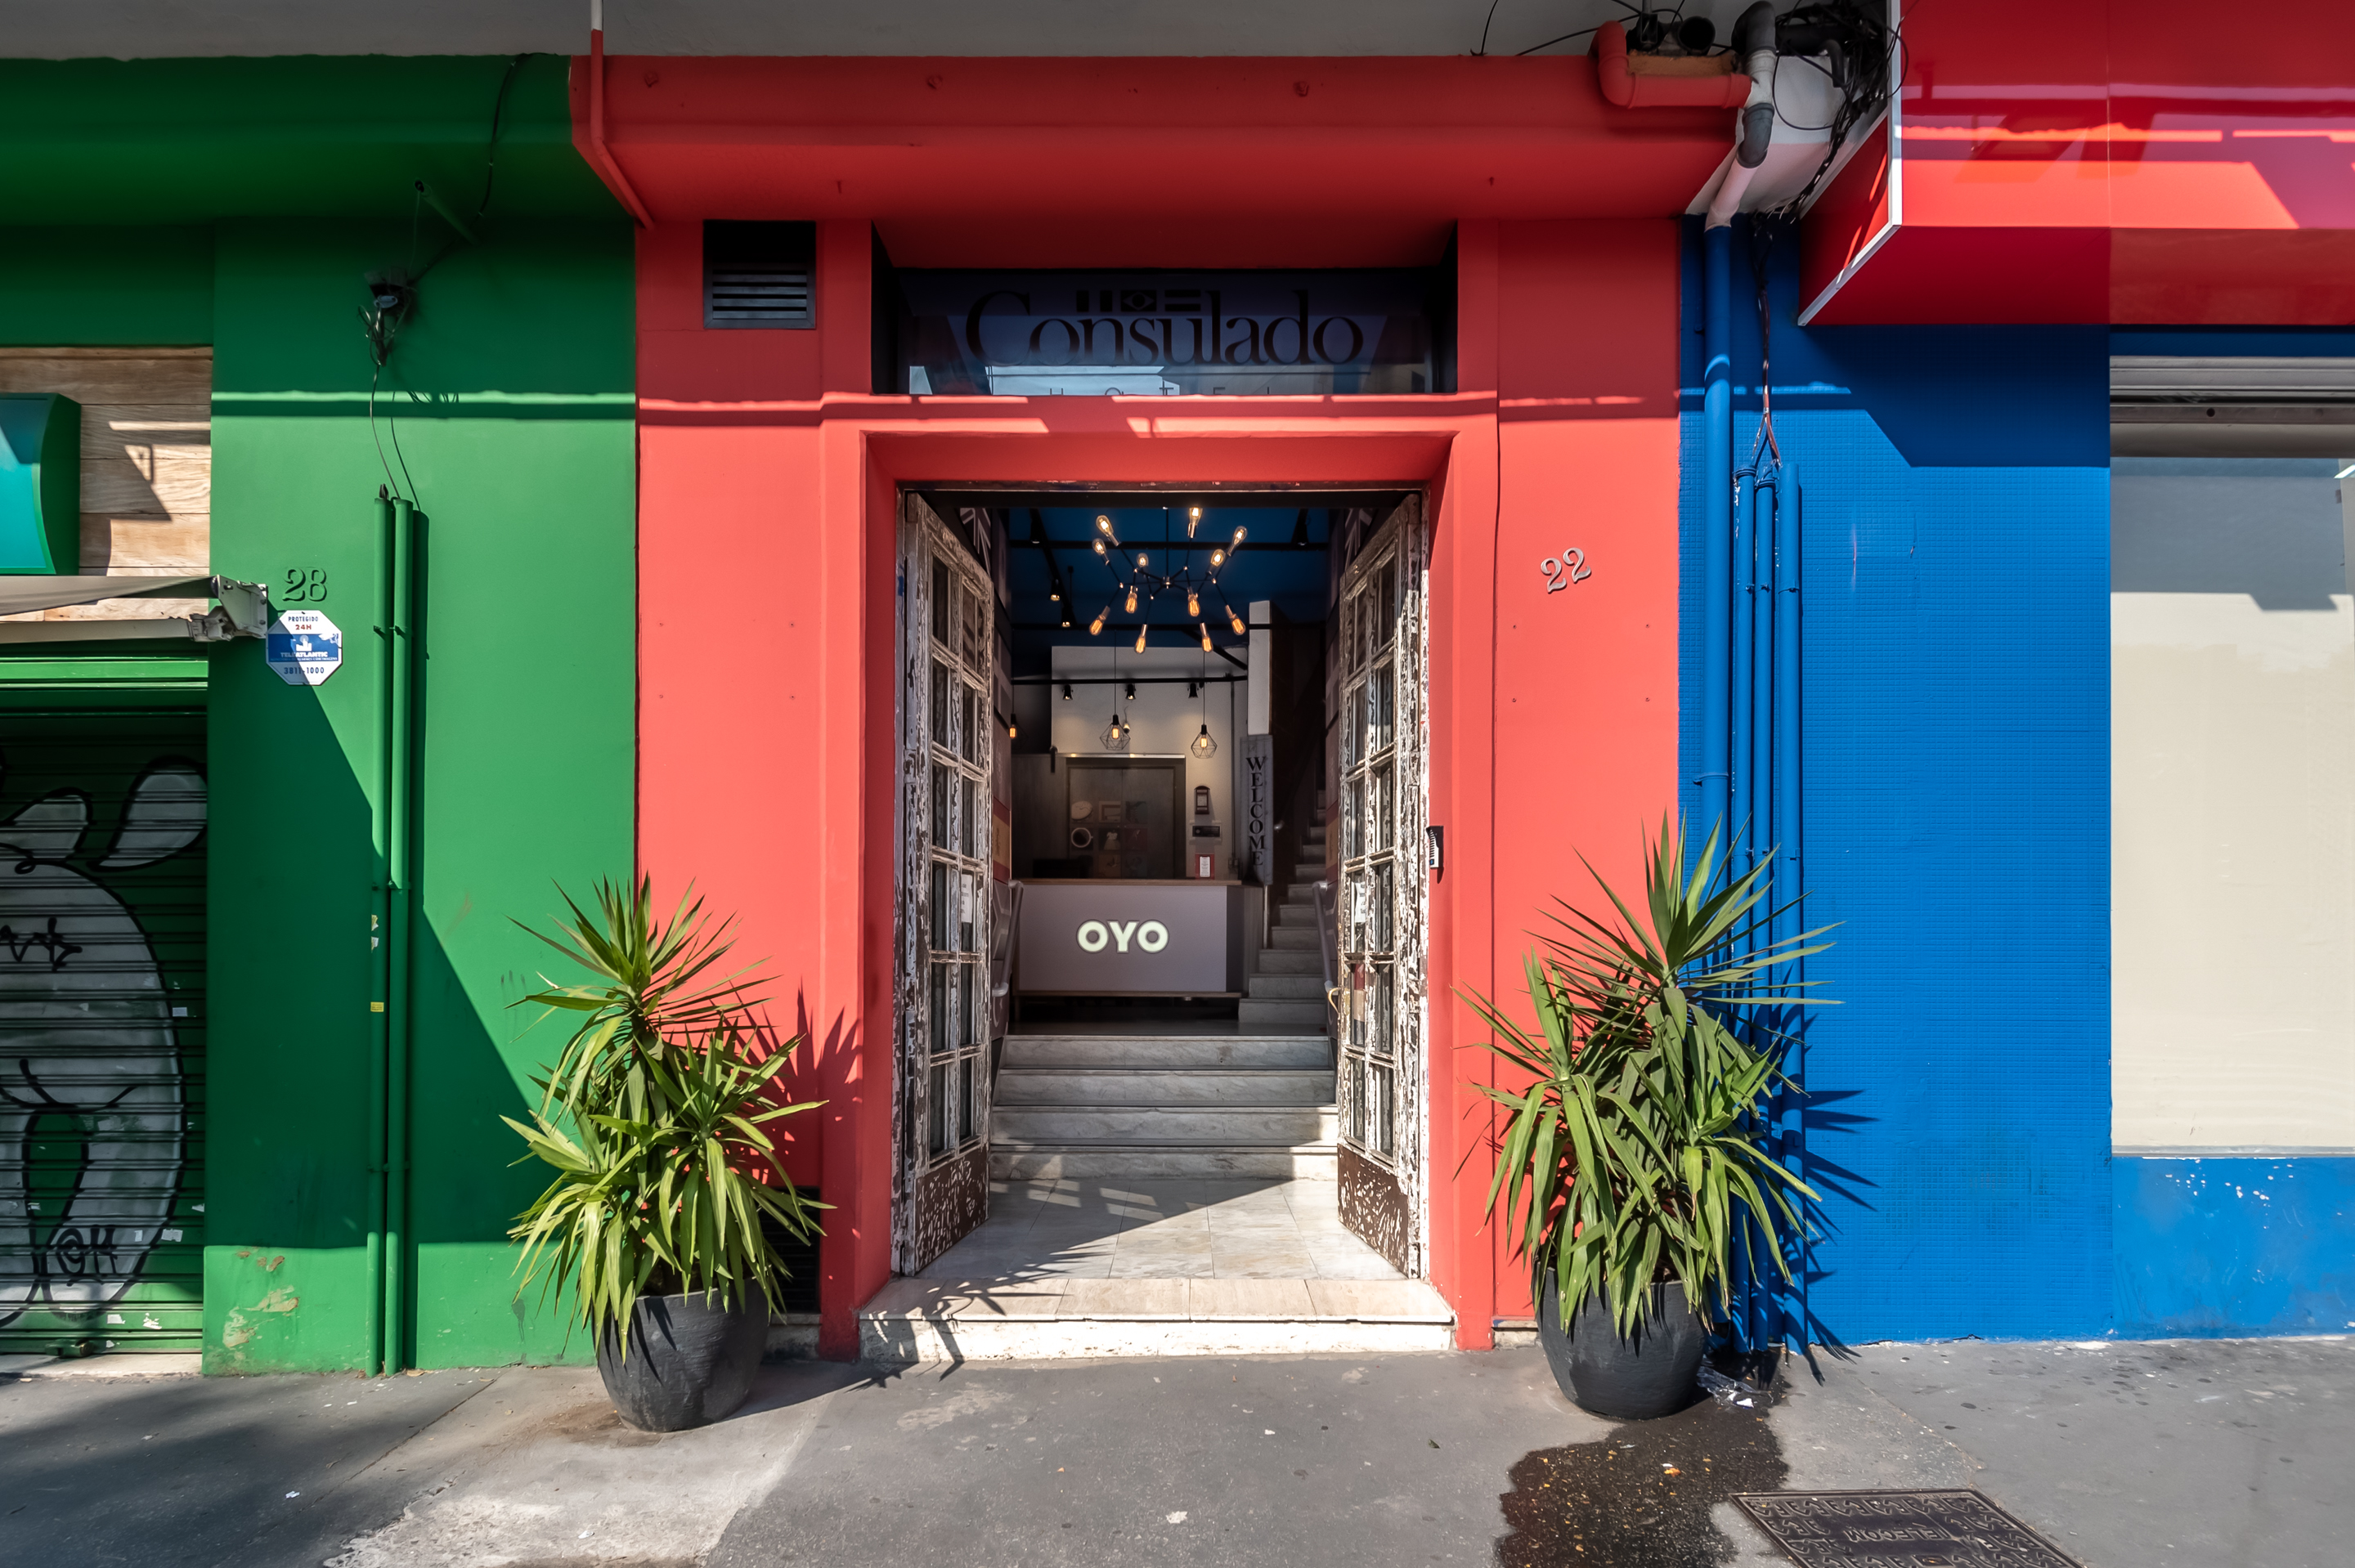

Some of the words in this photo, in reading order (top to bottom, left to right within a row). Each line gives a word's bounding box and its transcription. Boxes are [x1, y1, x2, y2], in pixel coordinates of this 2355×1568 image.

[966, 289, 1364, 366] Consulado
[282, 567, 328, 602] 28
[1540, 547, 1591, 594] 22
[284, 666, 325, 674] 3811-1000
[1245, 756, 1267, 866] WELCOME
[1076, 919, 1169, 954] OYO
